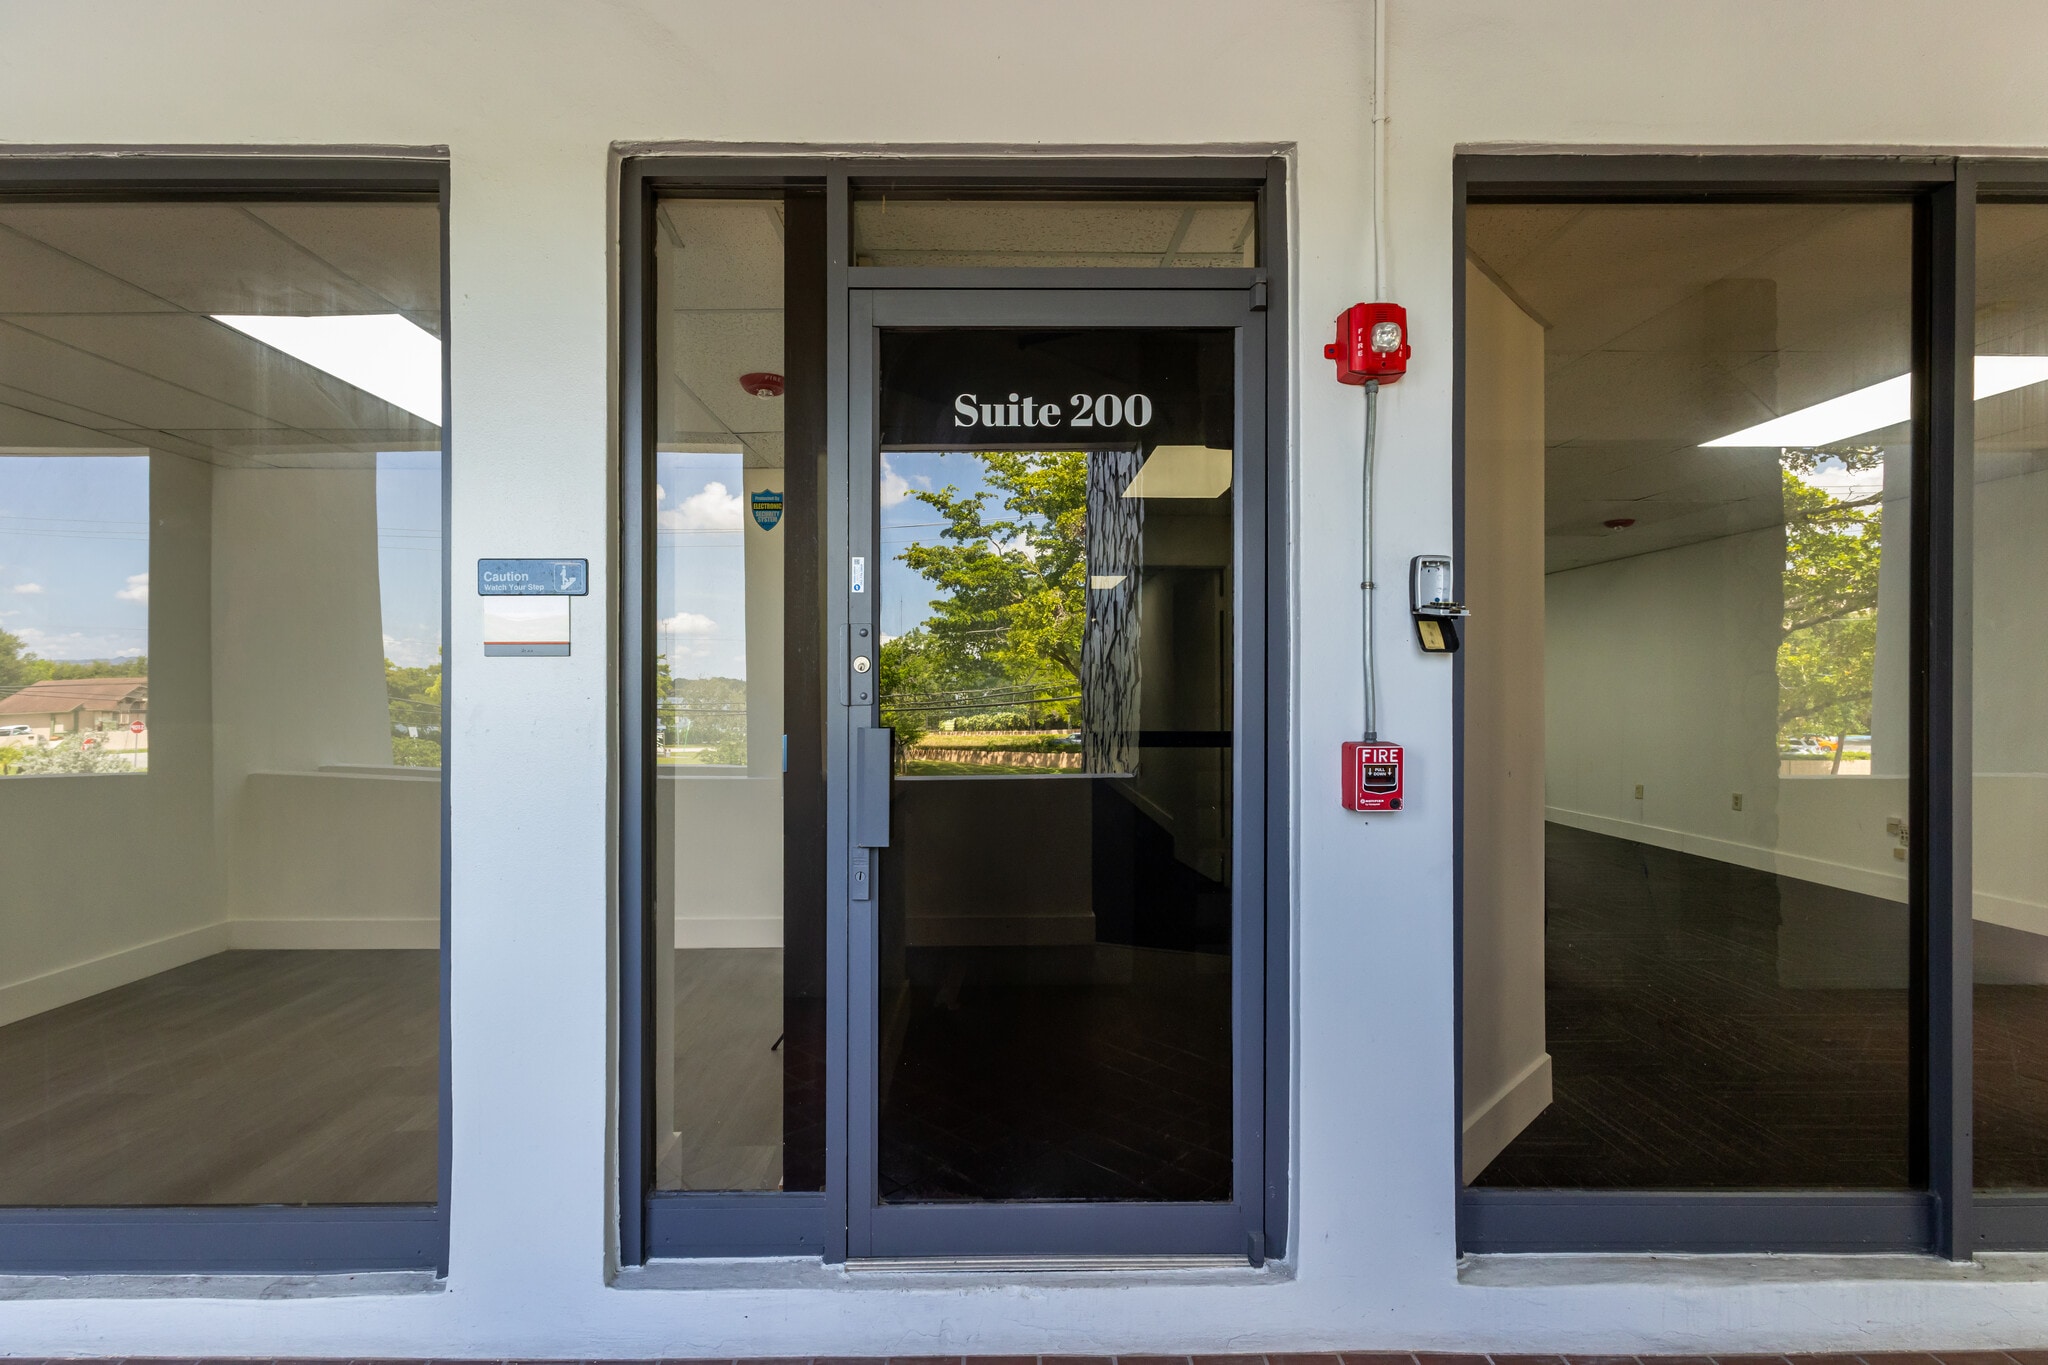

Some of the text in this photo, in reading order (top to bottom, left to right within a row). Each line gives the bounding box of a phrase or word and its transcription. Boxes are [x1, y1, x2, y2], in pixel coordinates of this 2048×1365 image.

[955, 393, 1153, 427] Suite 200
[483, 571, 529, 582] Caution
[527, 583, 545, 592] Step
[1362, 749, 1398, 762] FIRE
